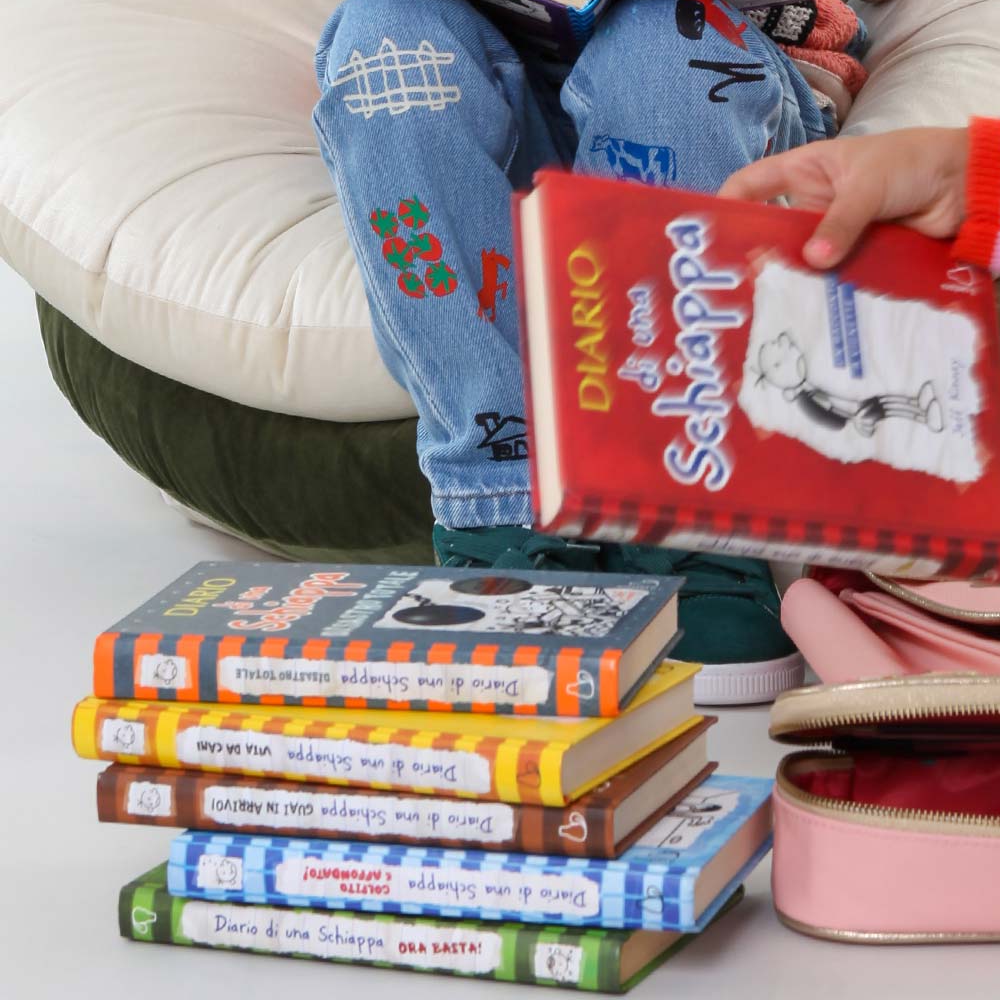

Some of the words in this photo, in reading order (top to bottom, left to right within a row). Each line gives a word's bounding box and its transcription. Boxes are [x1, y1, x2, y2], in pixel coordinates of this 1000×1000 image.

[627, 285, 659, 347] una
[568, 242, 611, 411] DIARIO
[651, 217, 746, 492] Schiappa
[617, 358, 662, 392] di
[163, 577, 237, 616] DIARIO
[227, 571, 367, 632] Schiappa
[236, 667, 275, 681] TOTALE
[278, 669, 331, 683] DISASTRO
[340, 667, 409, 692] Schiappa
[417, 676, 443, 687] una
[450, 679, 465, 694] di
[472, 678, 519, 697] Diario
[225, 743, 241, 756] DA
[245, 743, 272, 757] VITA
[287, 744, 353, 772] Schiappa
[360, 757, 385, 770] una
[392, 761, 405, 777] di
[412, 762, 458, 782] Diario
[211, 799, 263, 814] ARRIVO!
[266, 802, 280, 816] IN
[283, 802, 314, 817] GUAI
[321, 799, 386, 826] Schiappa
[395, 811, 420, 823] una
[426, 813, 441, 831] di
[447, 813, 494, 834] Diario
[302, 865, 382, 882] AFFONDATO!
[339, 882, 391, 896] COLPITO
[408, 872, 477, 900] Schiappa
[485, 885, 510, 897] una
[518, 887, 533, 905] di
[540, 887, 587, 908] Diario
[214, 914, 258, 936] Diario
[265, 920, 278, 938] di
[285, 927, 310, 940] una
[318, 926, 384, 955] Schiappa
[398, 941, 427, 955] ORA
[432, 941, 482, 955] BASTA!
